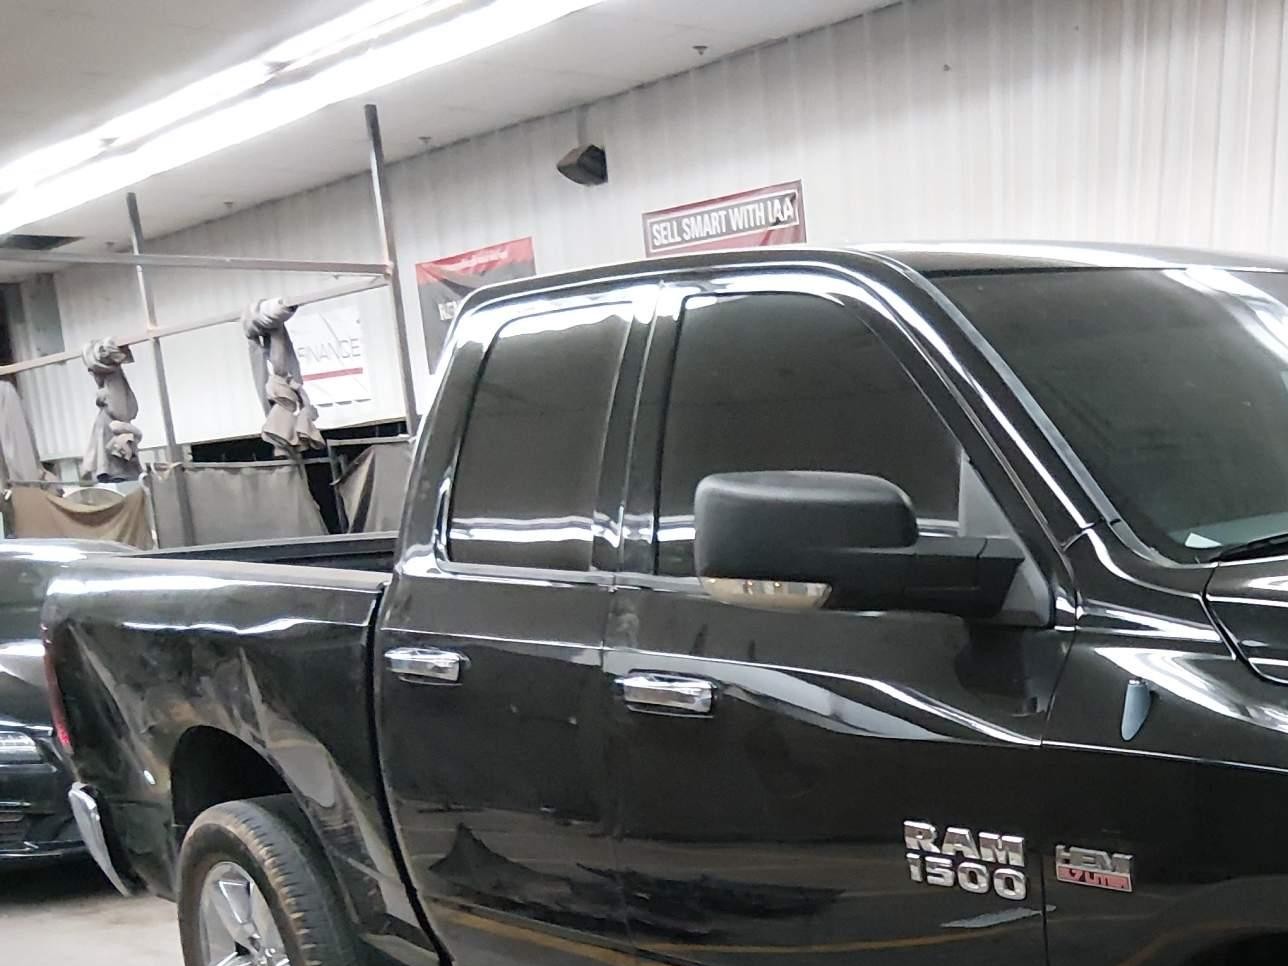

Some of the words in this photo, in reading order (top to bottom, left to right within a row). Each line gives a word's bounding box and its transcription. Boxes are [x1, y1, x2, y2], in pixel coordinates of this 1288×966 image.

[652, 220, 682, 246] SELL
[682, 210, 728, 241] SMART
[728, 201, 766, 232] WITH
[767, 195, 795, 223] IAA
[904, 820, 1025, 867] RAM
[906, 852, 1027, 901] 1500
